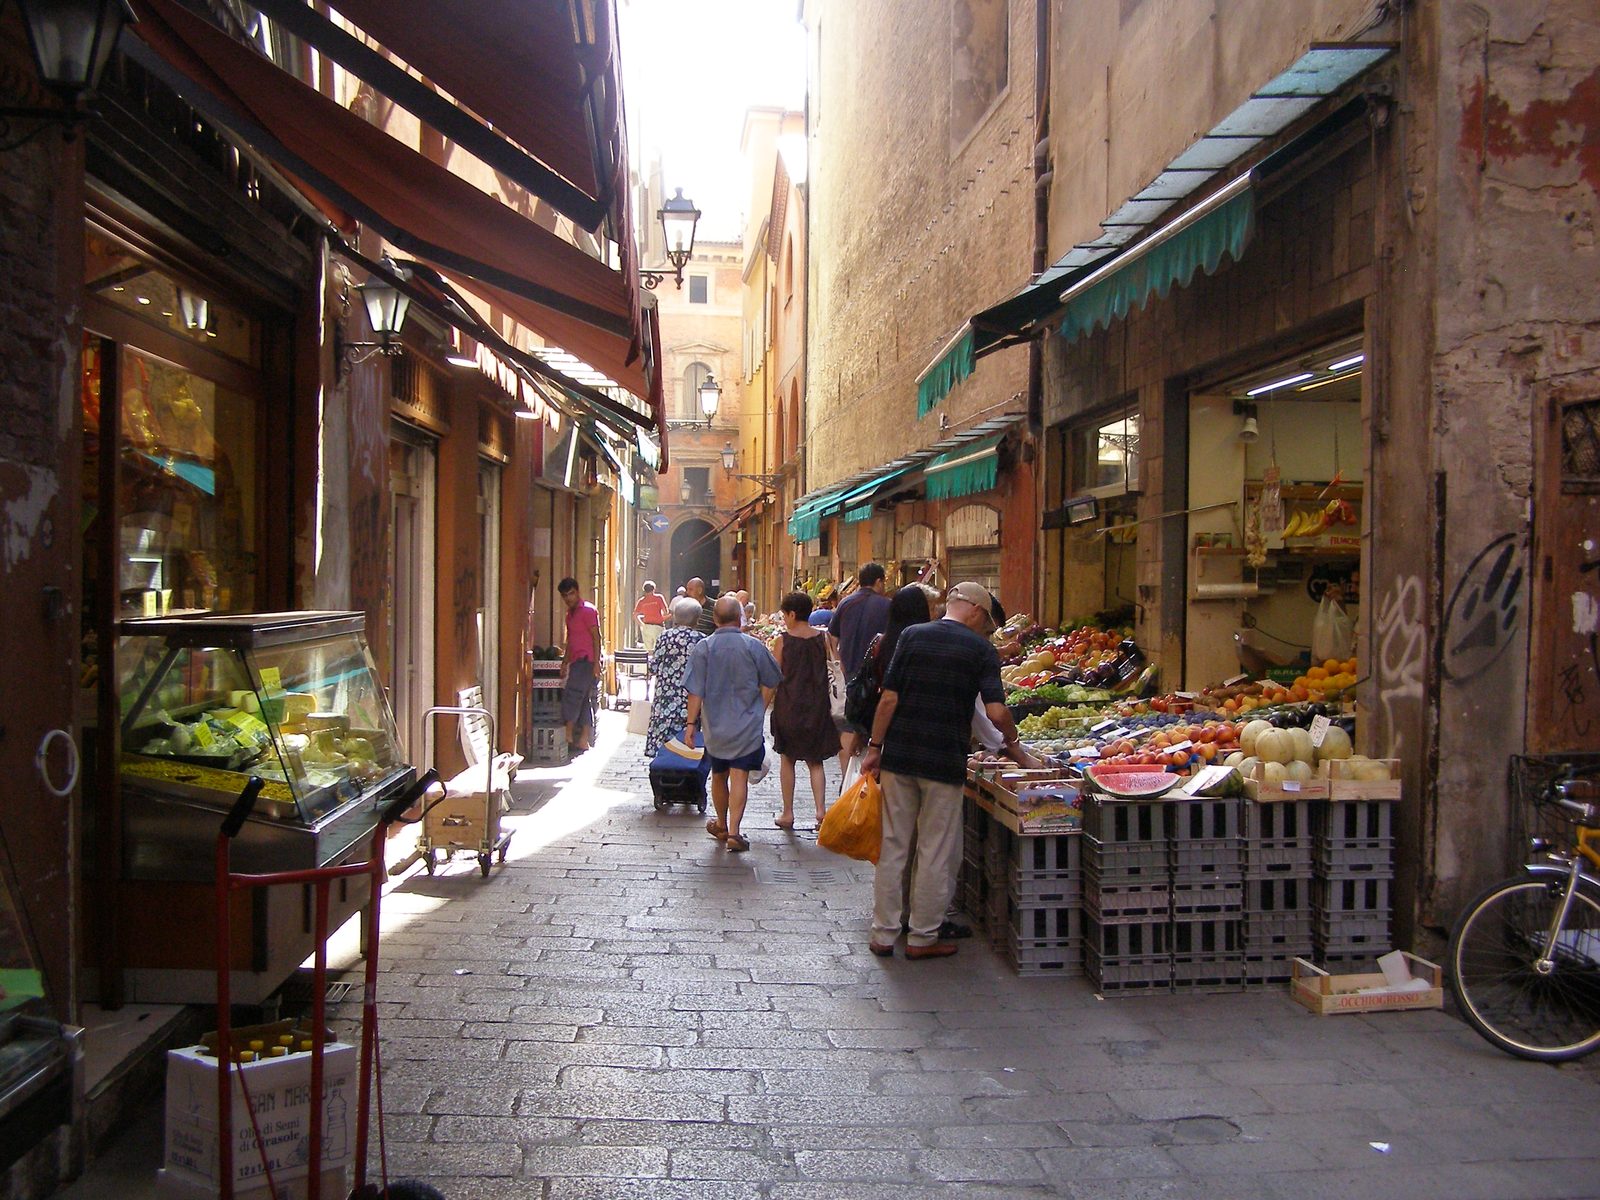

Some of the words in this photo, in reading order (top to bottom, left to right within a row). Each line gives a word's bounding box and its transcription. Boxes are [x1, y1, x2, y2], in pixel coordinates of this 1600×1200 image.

[263, 1122, 273, 1135] di
[275, 1117, 300, 1132] Semi
[239, 1140, 250, 1153] di
